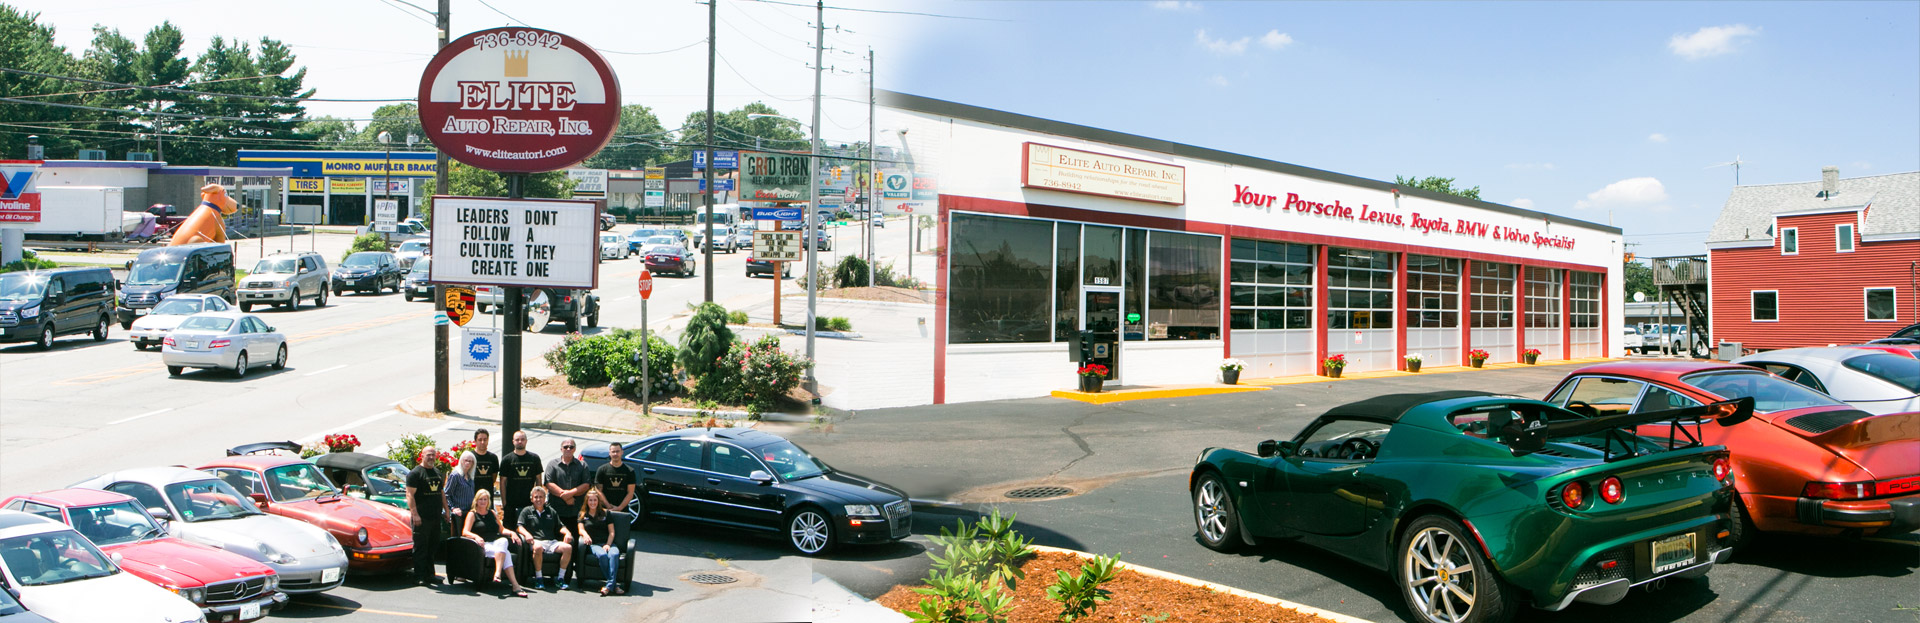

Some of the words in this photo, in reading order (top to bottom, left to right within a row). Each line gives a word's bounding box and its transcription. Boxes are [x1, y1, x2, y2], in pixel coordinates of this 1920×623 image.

[474, 31, 562, 50] 736-8942
[458, 81, 577, 111] ELITE
[465, 145, 567, 160] www.eliteautori.com
[325, 162, 361, 171] MONRO
[748, 156, 776, 176] GRID
[780, 156, 808, 176] IRON
[1059, 154, 1090, 168] ELITE
[296, 180, 318, 190] TIRES
[1043, 178, 1081, 190] 736-8942
[0, 201, 30, 210] lvoline
[457, 208, 509, 224] LEADERS
[525, 210, 558, 226] DONT
[1232, 184, 1276, 207] Your
[1282, 192, 1354, 220] Porsche,
[1359, 204, 1405, 227] Lexus,
[1410, 212, 1452, 233] Toyota,
[1455, 219, 1489, 237] BMW
[1493, 226, 1501, 239] &
[1503, 227, 1530, 243] Volvo
[1532, 231, 1575, 250] Specialist
[463, 225, 511, 242] FOLLOW
[526, 227, 534, 243] A
[460, 242, 514, 259] CULTURE
[525, 244, 556, 260] THEY
[471, 260, 518, 276] CREATE
[526, 261, 549, 277] ONE
[639, 280, 652, 291] STOP
[471, 344, 489, 353] ASE
[1889, 480, 1920, 491] POR
